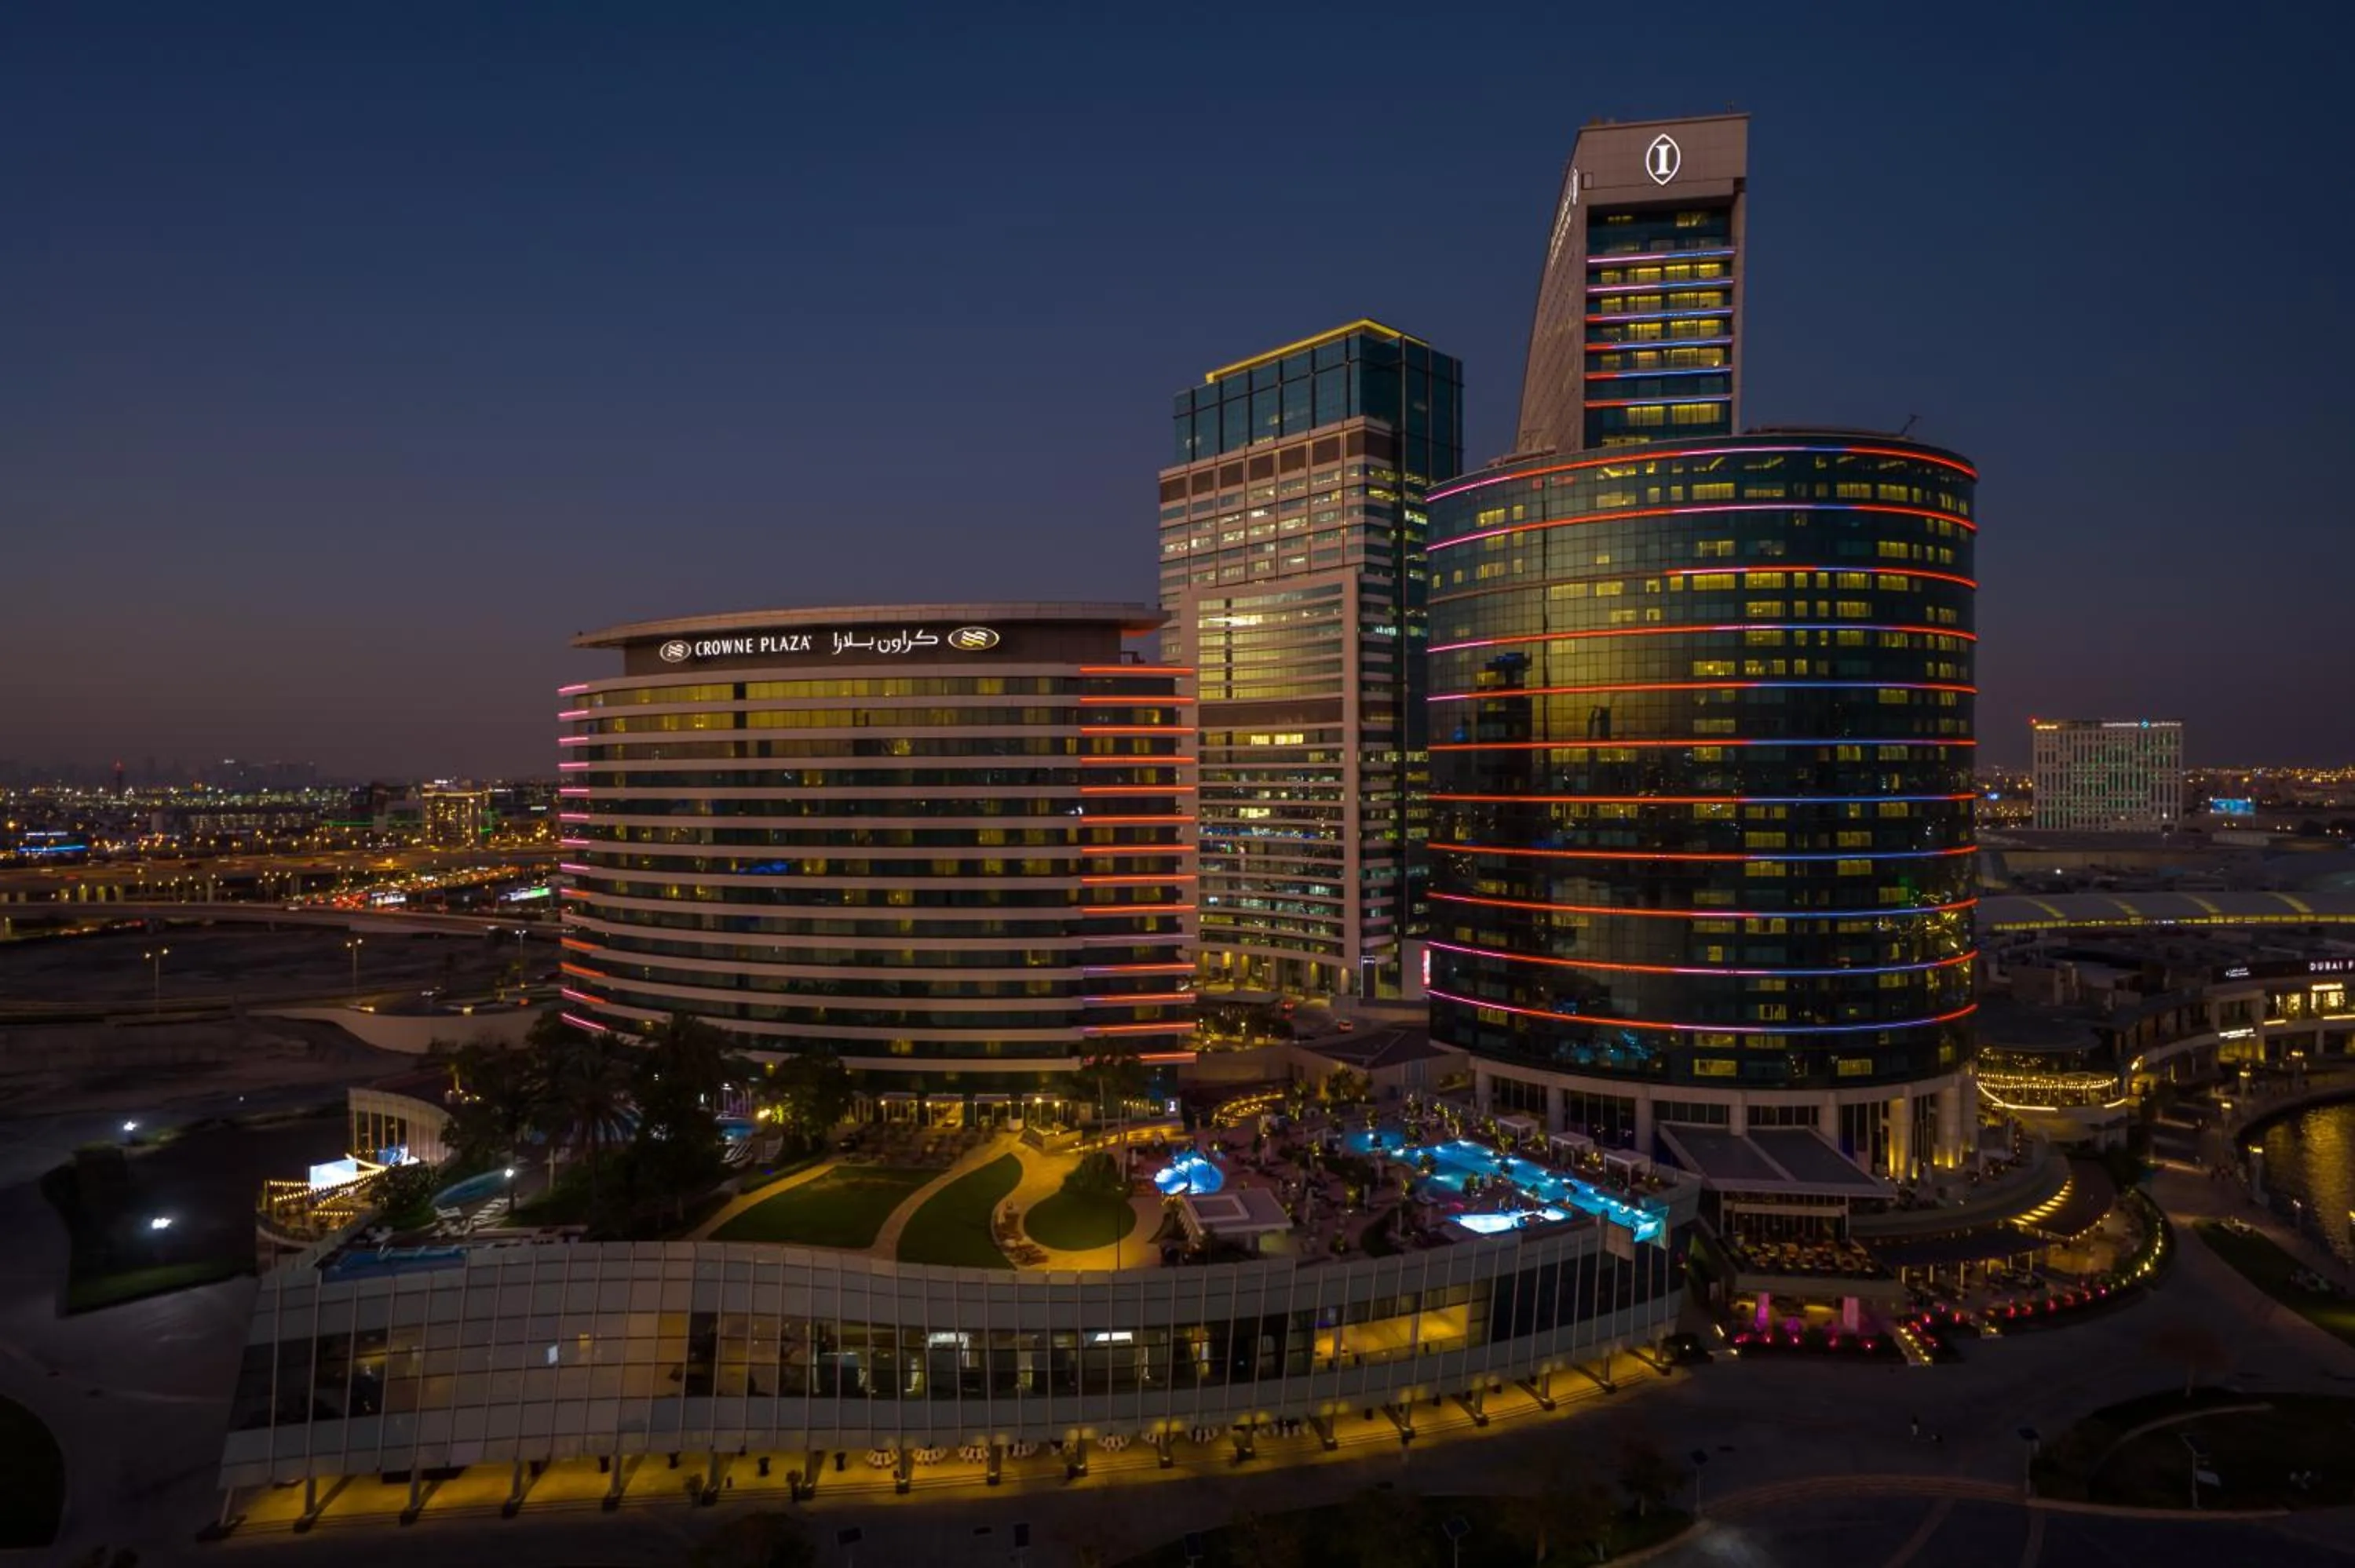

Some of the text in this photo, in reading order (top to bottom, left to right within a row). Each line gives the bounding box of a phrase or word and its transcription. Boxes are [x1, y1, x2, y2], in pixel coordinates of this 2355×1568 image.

[695, 635, 810, 656] CROWNE PLAZA
[832, 629, 939, 655] كراون بلازا
